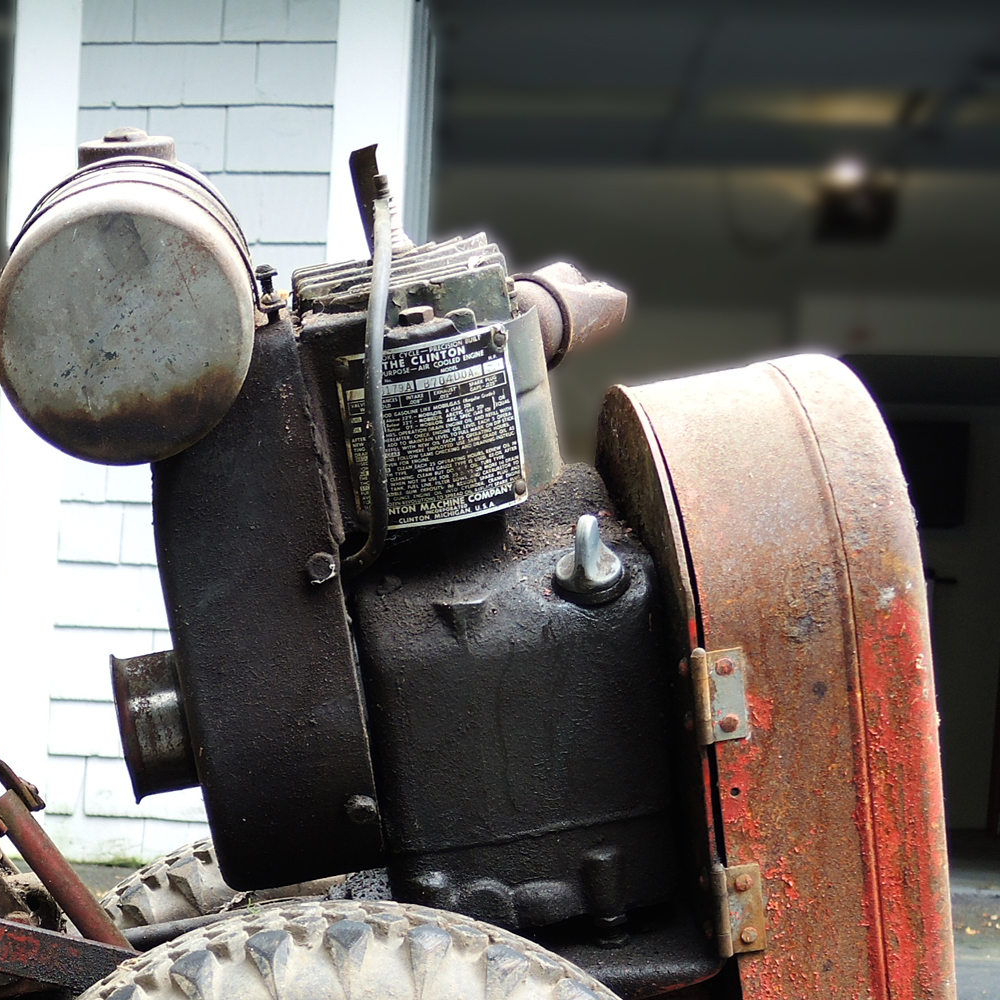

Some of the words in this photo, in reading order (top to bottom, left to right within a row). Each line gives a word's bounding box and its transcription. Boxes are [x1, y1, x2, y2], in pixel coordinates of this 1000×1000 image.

[382, 359, 405, 370] THE
[410, 345, 466, 366] CLINTON
[433, 356, 461, 368] COOLED
[462, 349, 484, 361] ENGINE
[440, 365, 458, 373] MODEL
[469, 379, 484, 387] SPARK
[433, 386, 457, 395] EXHAUST
[393, 409, 418, 417] GASOLINE
[433, 400, 461, 410] MOBILGAS
[388, 505, 416, 515] NTON
[420, 496, 465, 512] MACHINE
[467, 483, 513, 503] COMPANY
[425, 503, 468, 515] INCORPORATED
